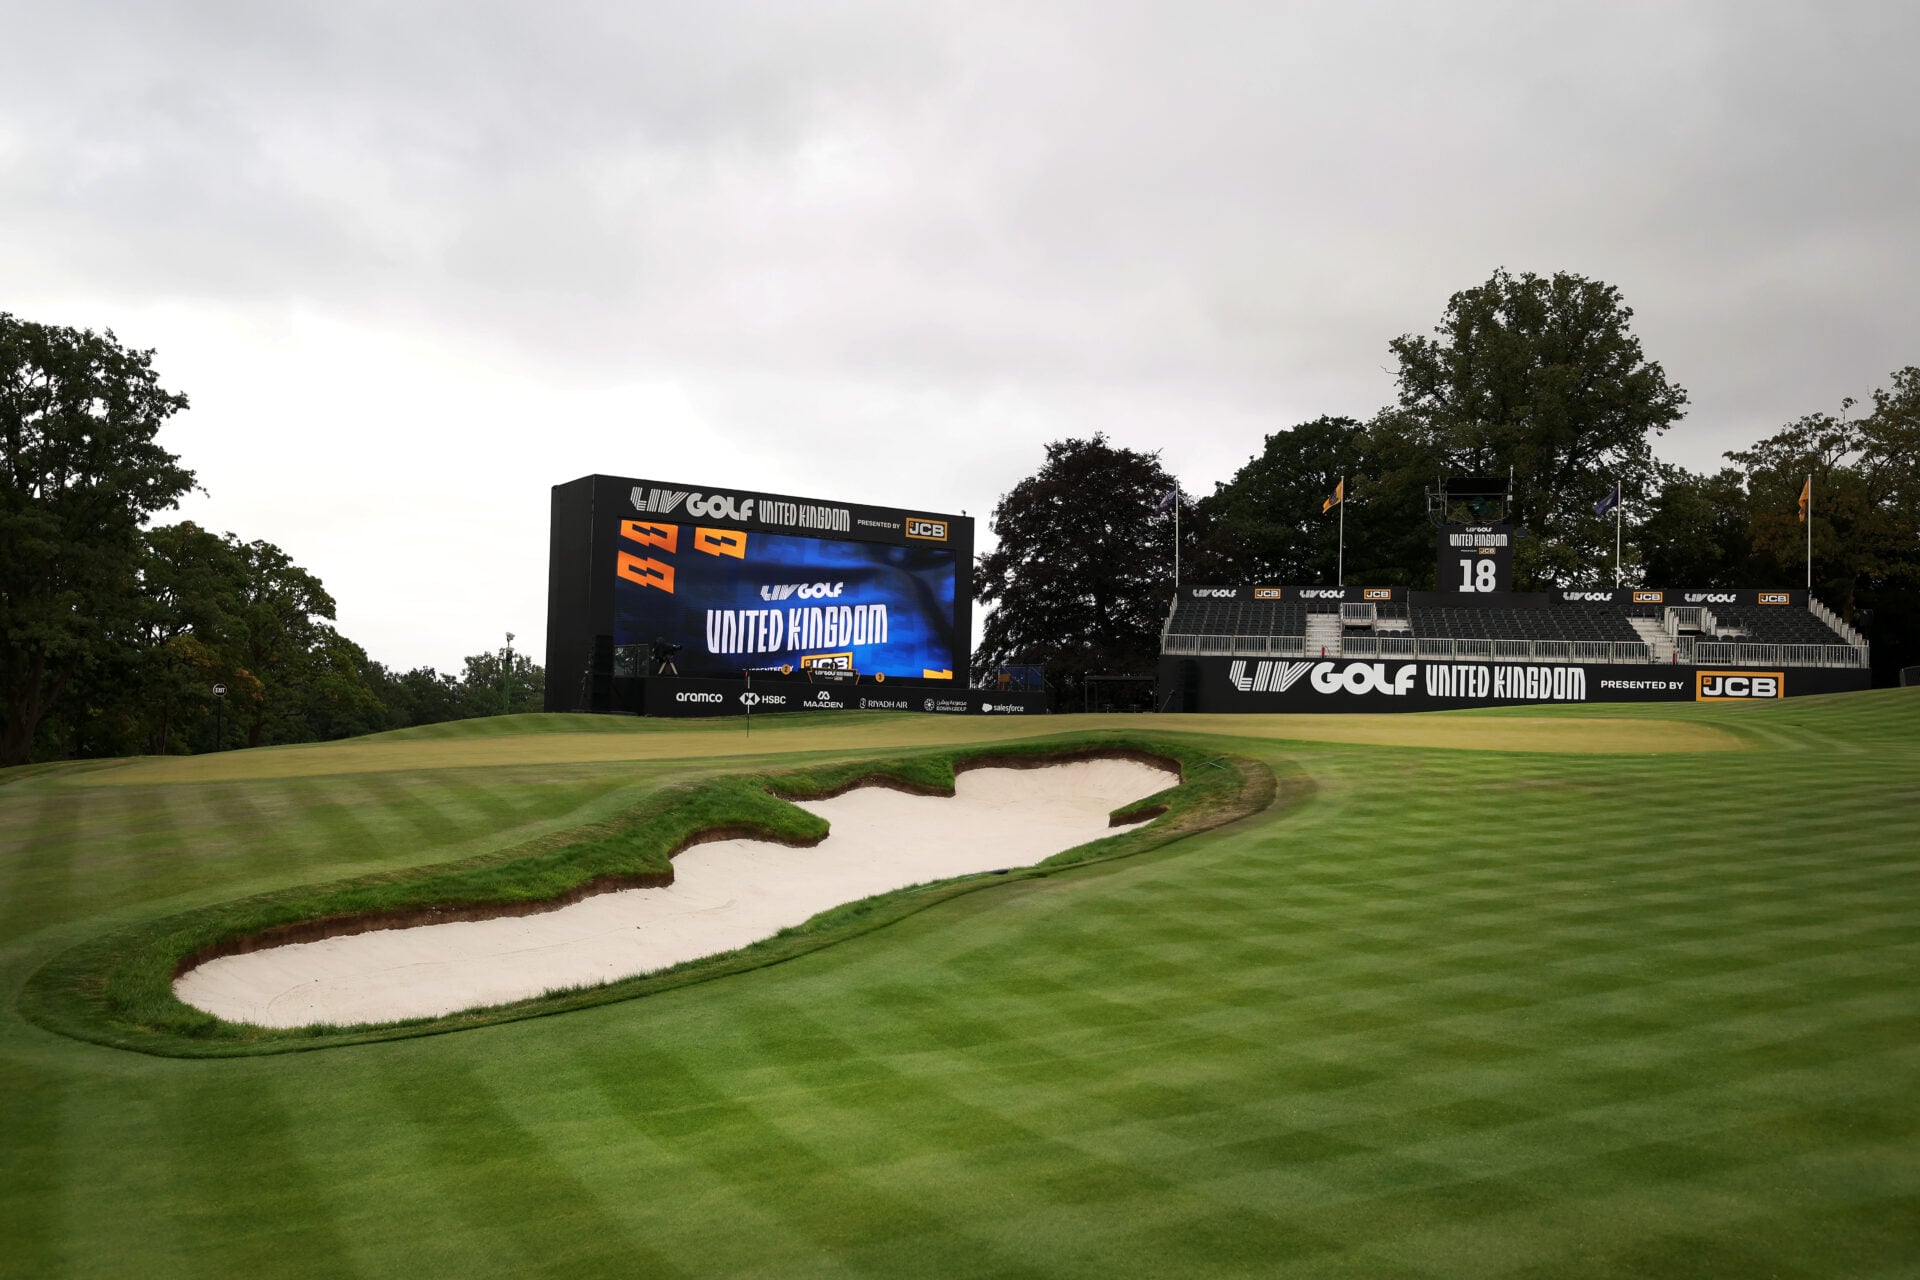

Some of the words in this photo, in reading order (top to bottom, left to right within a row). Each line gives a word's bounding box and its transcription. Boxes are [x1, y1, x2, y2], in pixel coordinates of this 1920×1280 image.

[759, 499, 798, 527] UNITED
[799, 504, 850, 532] KINGDOM
[857, 519, 893, 529] PRESENTED
[909, 522, 945, 538] JCB
[1449, 533, 1474, 547] UNITED
[1474, 533, 1508, 547] KINGDOM
[1459, 559, 1496, 593] 18
[1635, 593, 1661, 601] JCB
[706, 608, 784, 654] UNITED
[787, 603, 888, 651] KINGDOM
[1310, 662, 1417, 696] GOLF
[1425, 664, 1490, 698] UNITED
[1494, 665, 1586, 700] KINGDOM
[1601, 680, 1667, 690] PRESENTED
[1669, 681, 1684, 691] BY
[1703, 677, 1777, 698] JCB
[676, 692, 723, 703] aramco
[761, 695, 787, 704] HSBC
[803, 700, 844, 709] MAADEN
[868, 699, 895, 708] RIYADH
[896, 700, 908, 709] AIR
[993, 703, 1024, 713] salesforce
